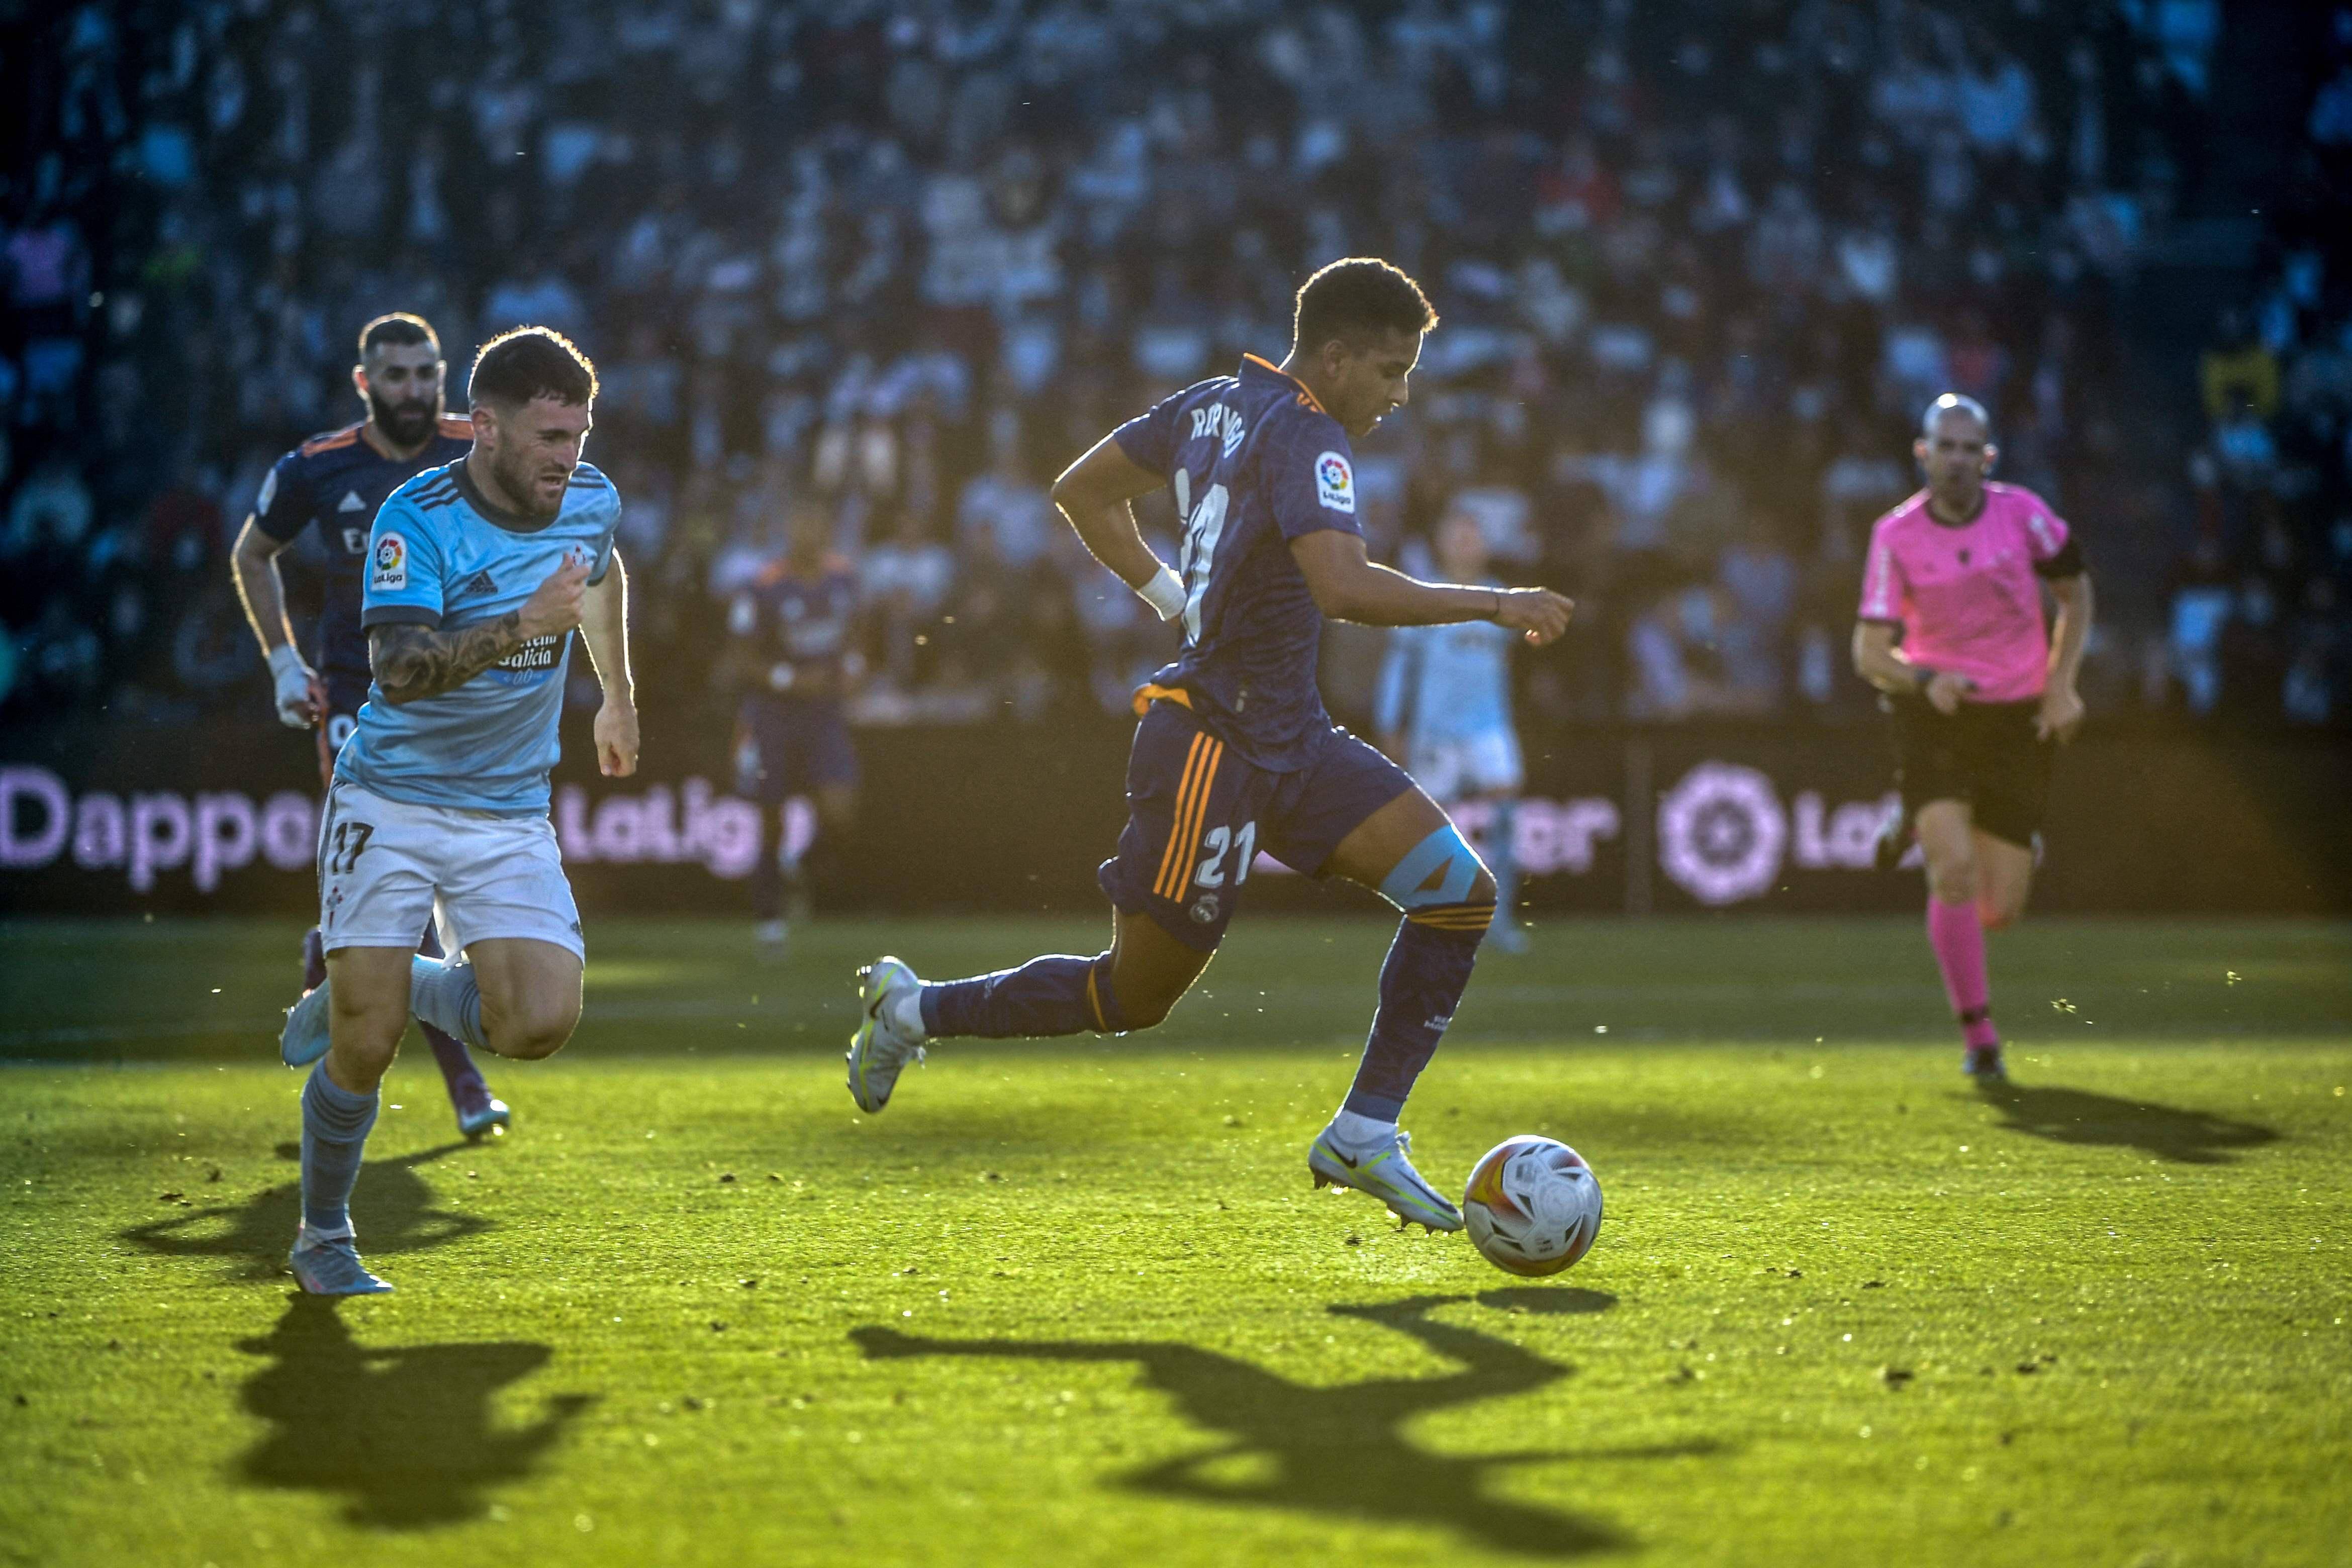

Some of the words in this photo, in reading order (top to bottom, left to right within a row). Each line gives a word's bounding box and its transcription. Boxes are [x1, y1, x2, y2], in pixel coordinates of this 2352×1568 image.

[373, 572, 403, 584] LaLiga
[0, 765, 332, 892] Dappe
[332, 822, 374, 875] 17
[556, 777, 817, 878] LaLig
[1194, 820, 1256, 889] 21
